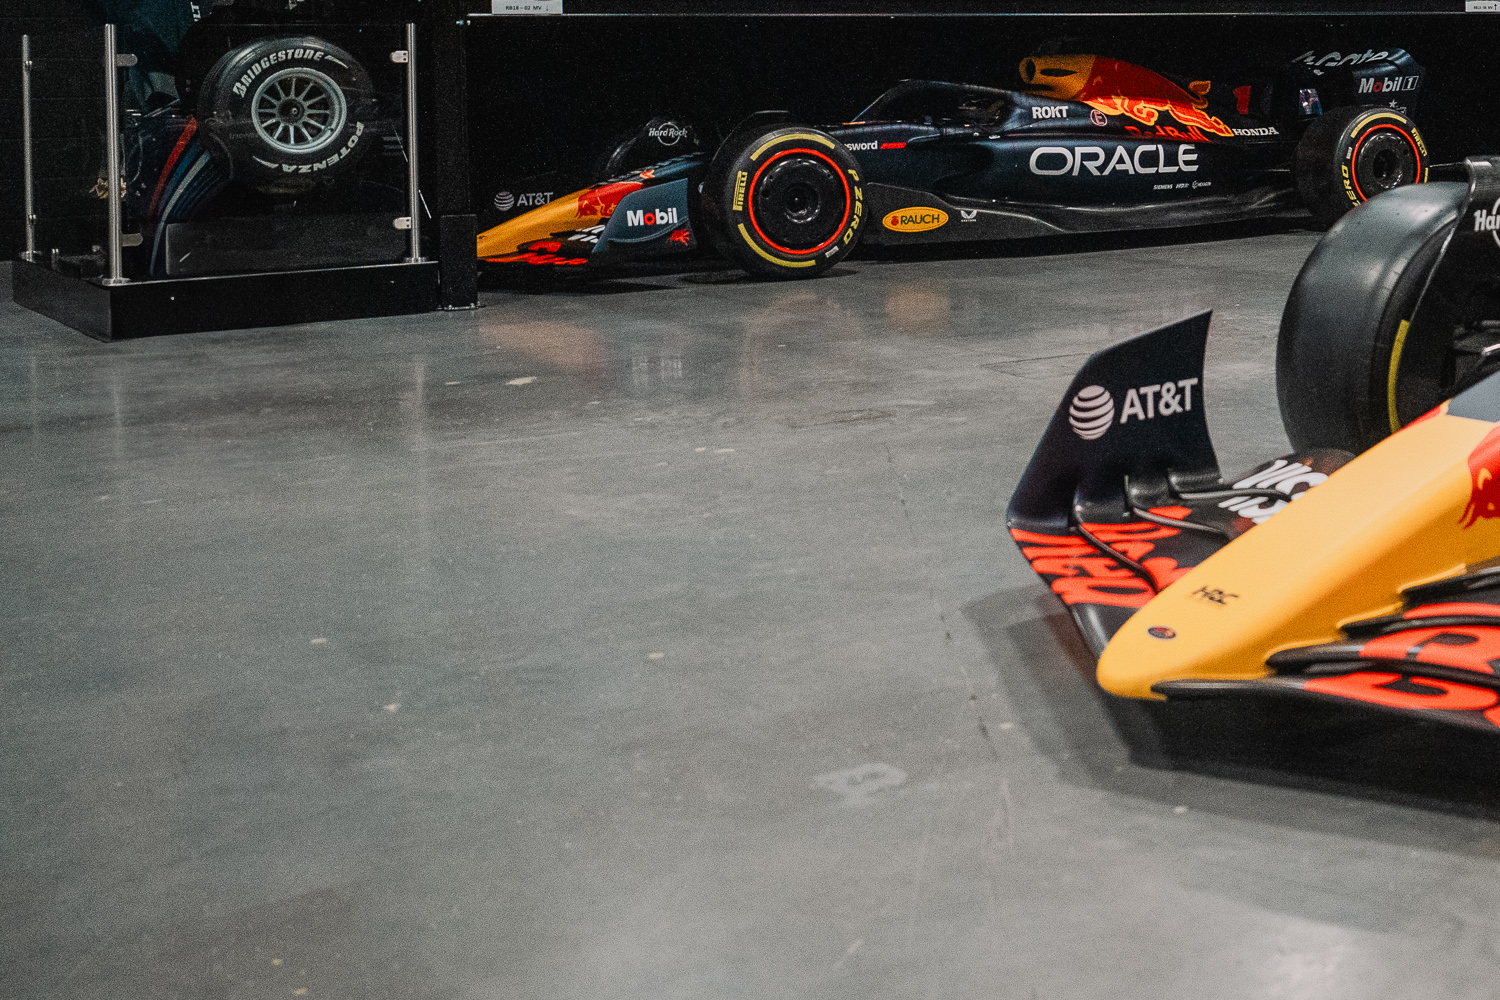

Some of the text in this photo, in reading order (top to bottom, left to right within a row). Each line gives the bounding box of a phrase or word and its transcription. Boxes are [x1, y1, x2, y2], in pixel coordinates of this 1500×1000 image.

[232, 48, 325, 98] BRIDGESTONE
[1358, 76, 1402, 95] Mobil
[1032, 105, 1069, 119] ROKT
[1232, 125, 1280, 138] HONDA
[282, 120, 365, 174] POTENZA
[843, 139, 878, 152] sword
[1029, 143, 1200, 176] ORACLE
[517, 191, 554, 207] AT&T
[732, 170, 748, 212] PIRELLI
[626, 207, 678, 227] Mobil
[842, 185, 863, 246] ZERO
[900, 212, 941, 226] RAUCH
[1119, 377, 1199, 425] AT&T
